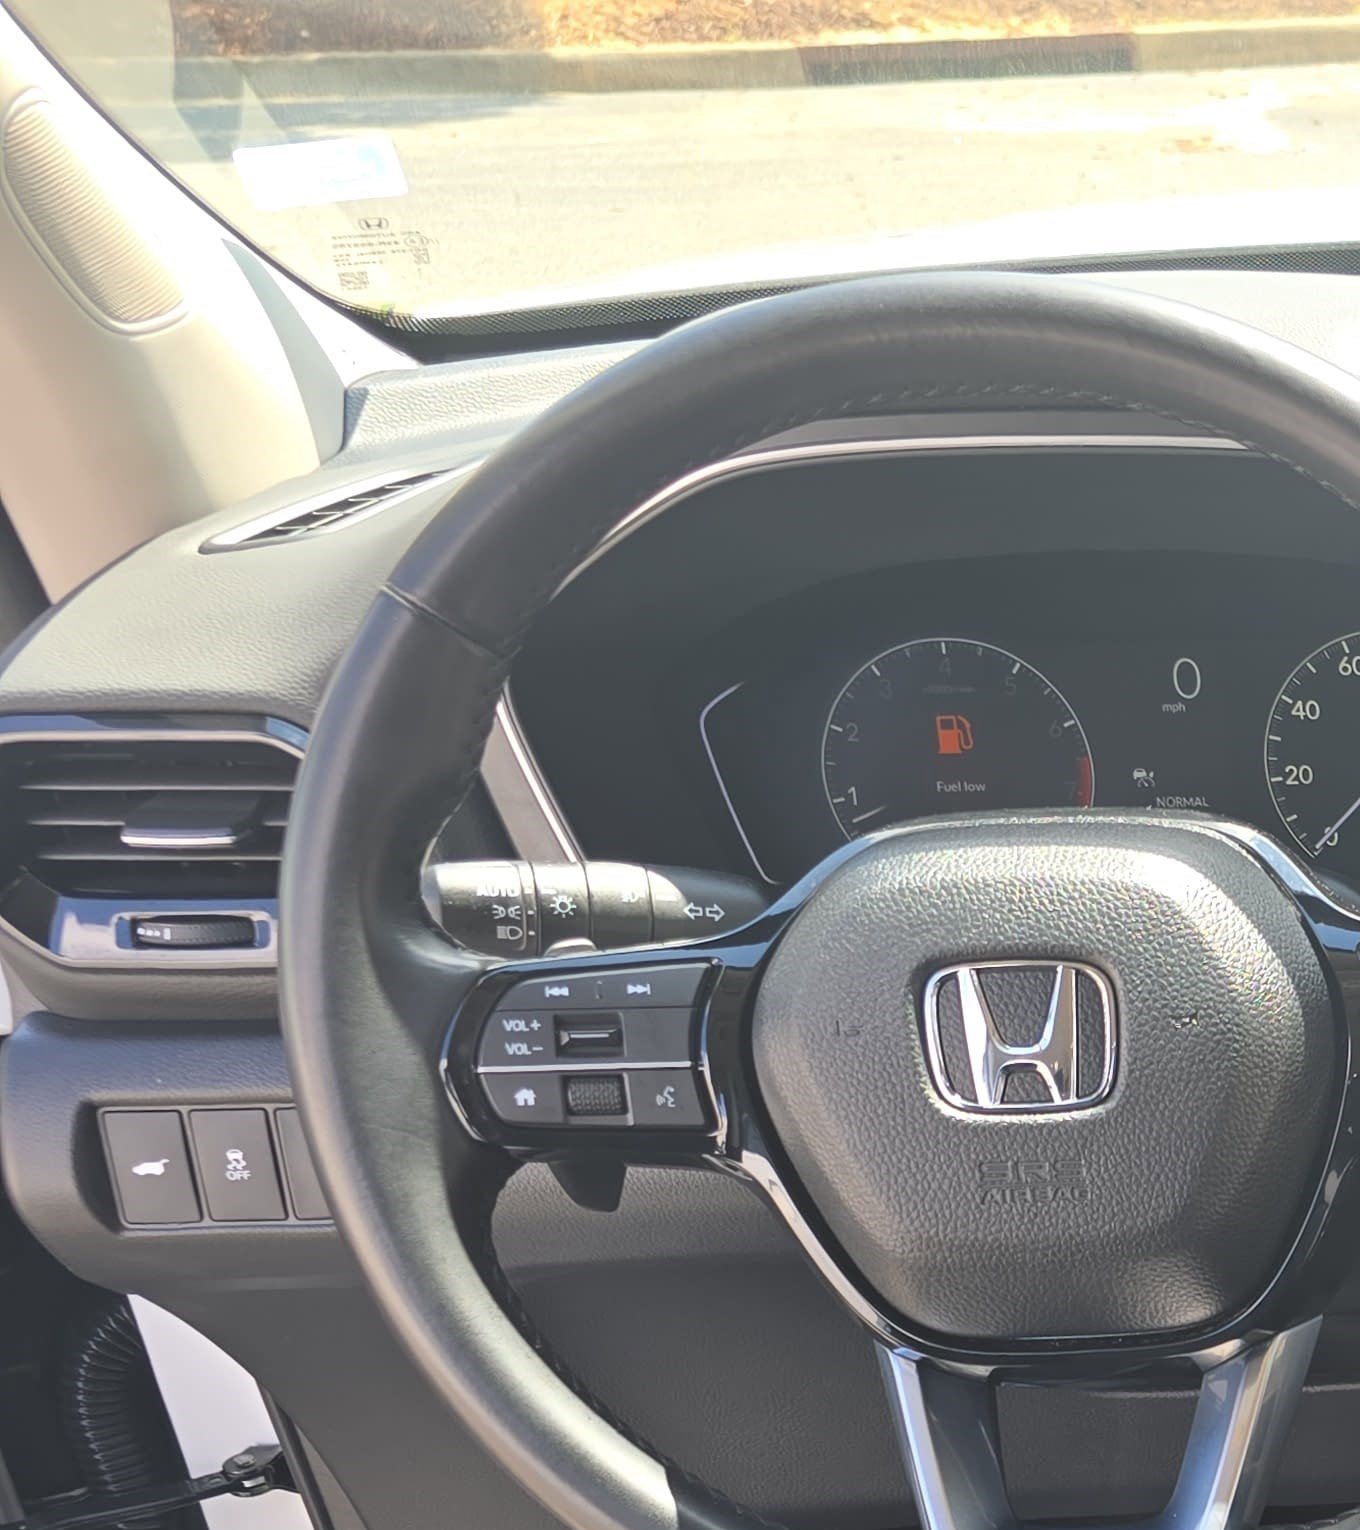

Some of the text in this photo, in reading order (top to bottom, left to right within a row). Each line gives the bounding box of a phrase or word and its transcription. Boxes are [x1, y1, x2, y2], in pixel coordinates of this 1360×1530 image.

[1004, 678, 1017, 696] 5
[1172, 657, 1202, 699] 0
[880, 679, 893, 697] 3
[1162, 702, 1186, 713] mph
[1291, 701, 1321, 721] 40
[847, 723, 860, 742] 2
[1284, 765, 1314, 785] 20
[847, 786, 858, 806] 1
[936, 781, 986, 793] Fuel low
[1156, 797, 1209, 808] NORMAL
[225, 1170, 252, 1181] OFF
